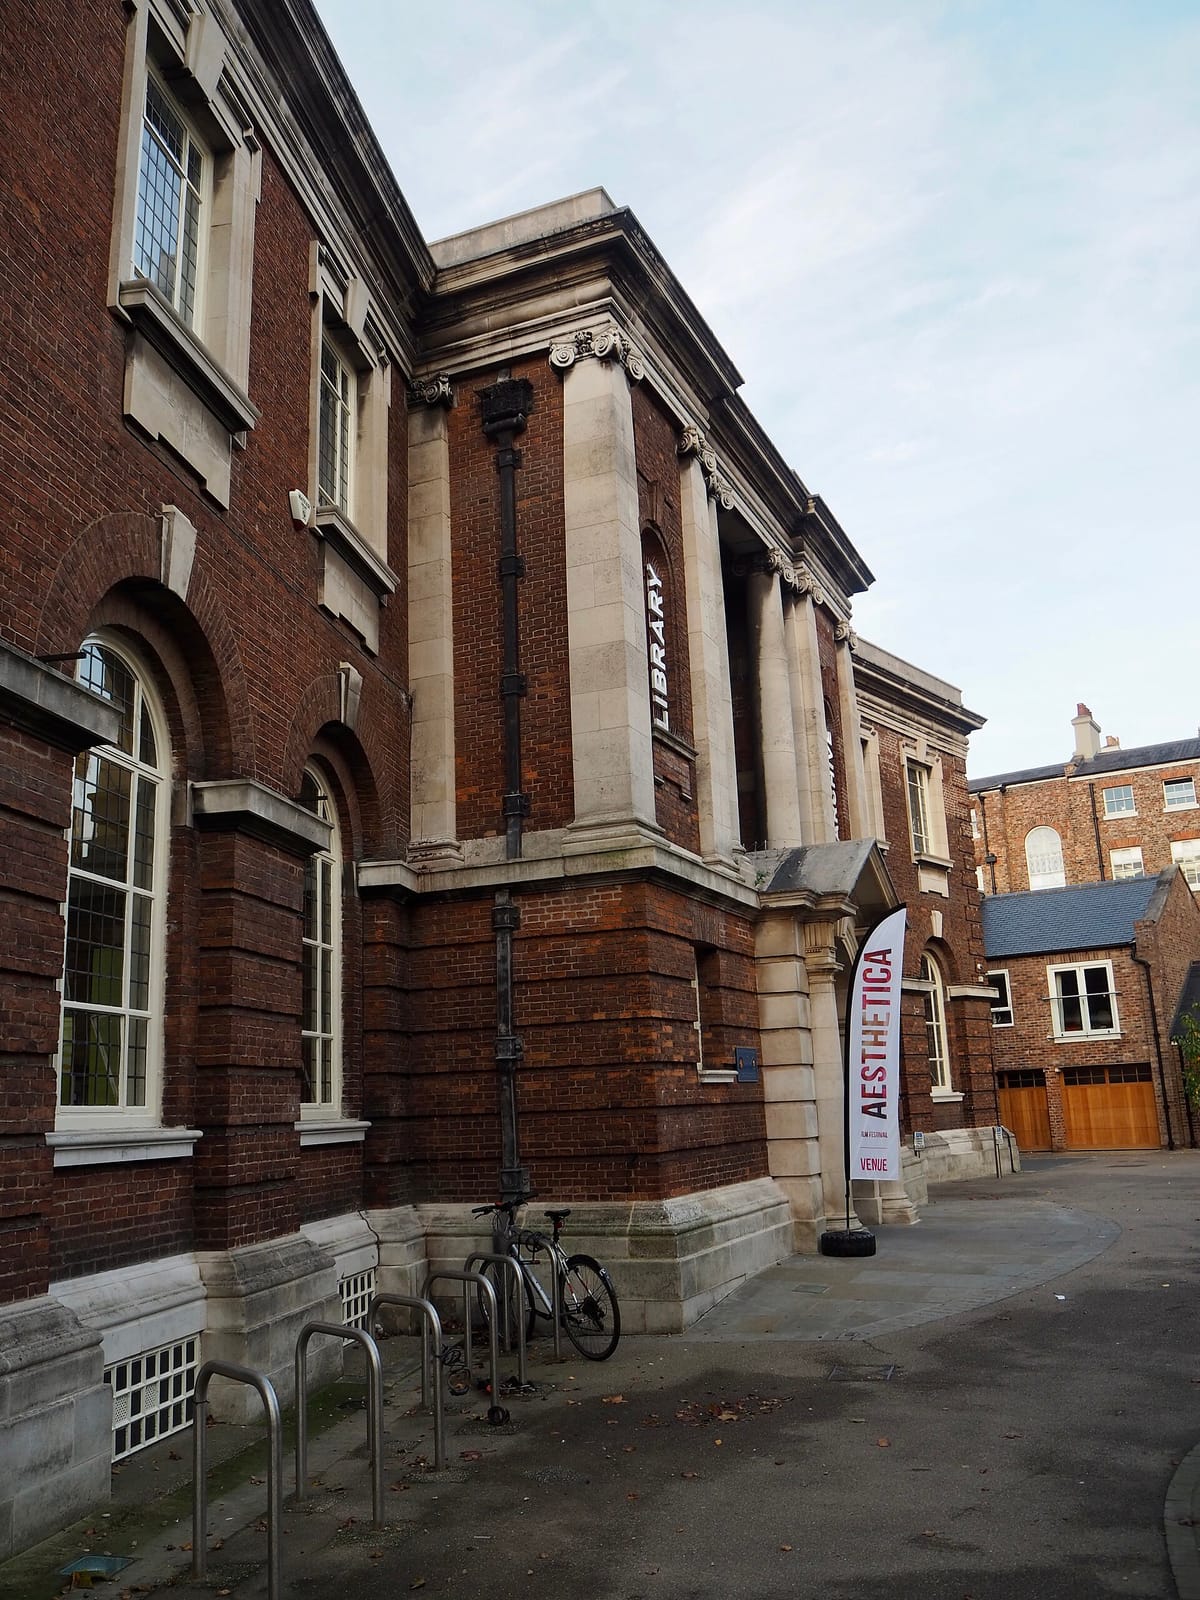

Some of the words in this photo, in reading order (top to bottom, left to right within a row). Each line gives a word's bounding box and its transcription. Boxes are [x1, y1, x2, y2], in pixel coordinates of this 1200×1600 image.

[647, 563, 669, 732] LIBRARY
[861, 948, 892, 1120] AESTHETICA
[860, 1157, 888, 1172] VENUE
